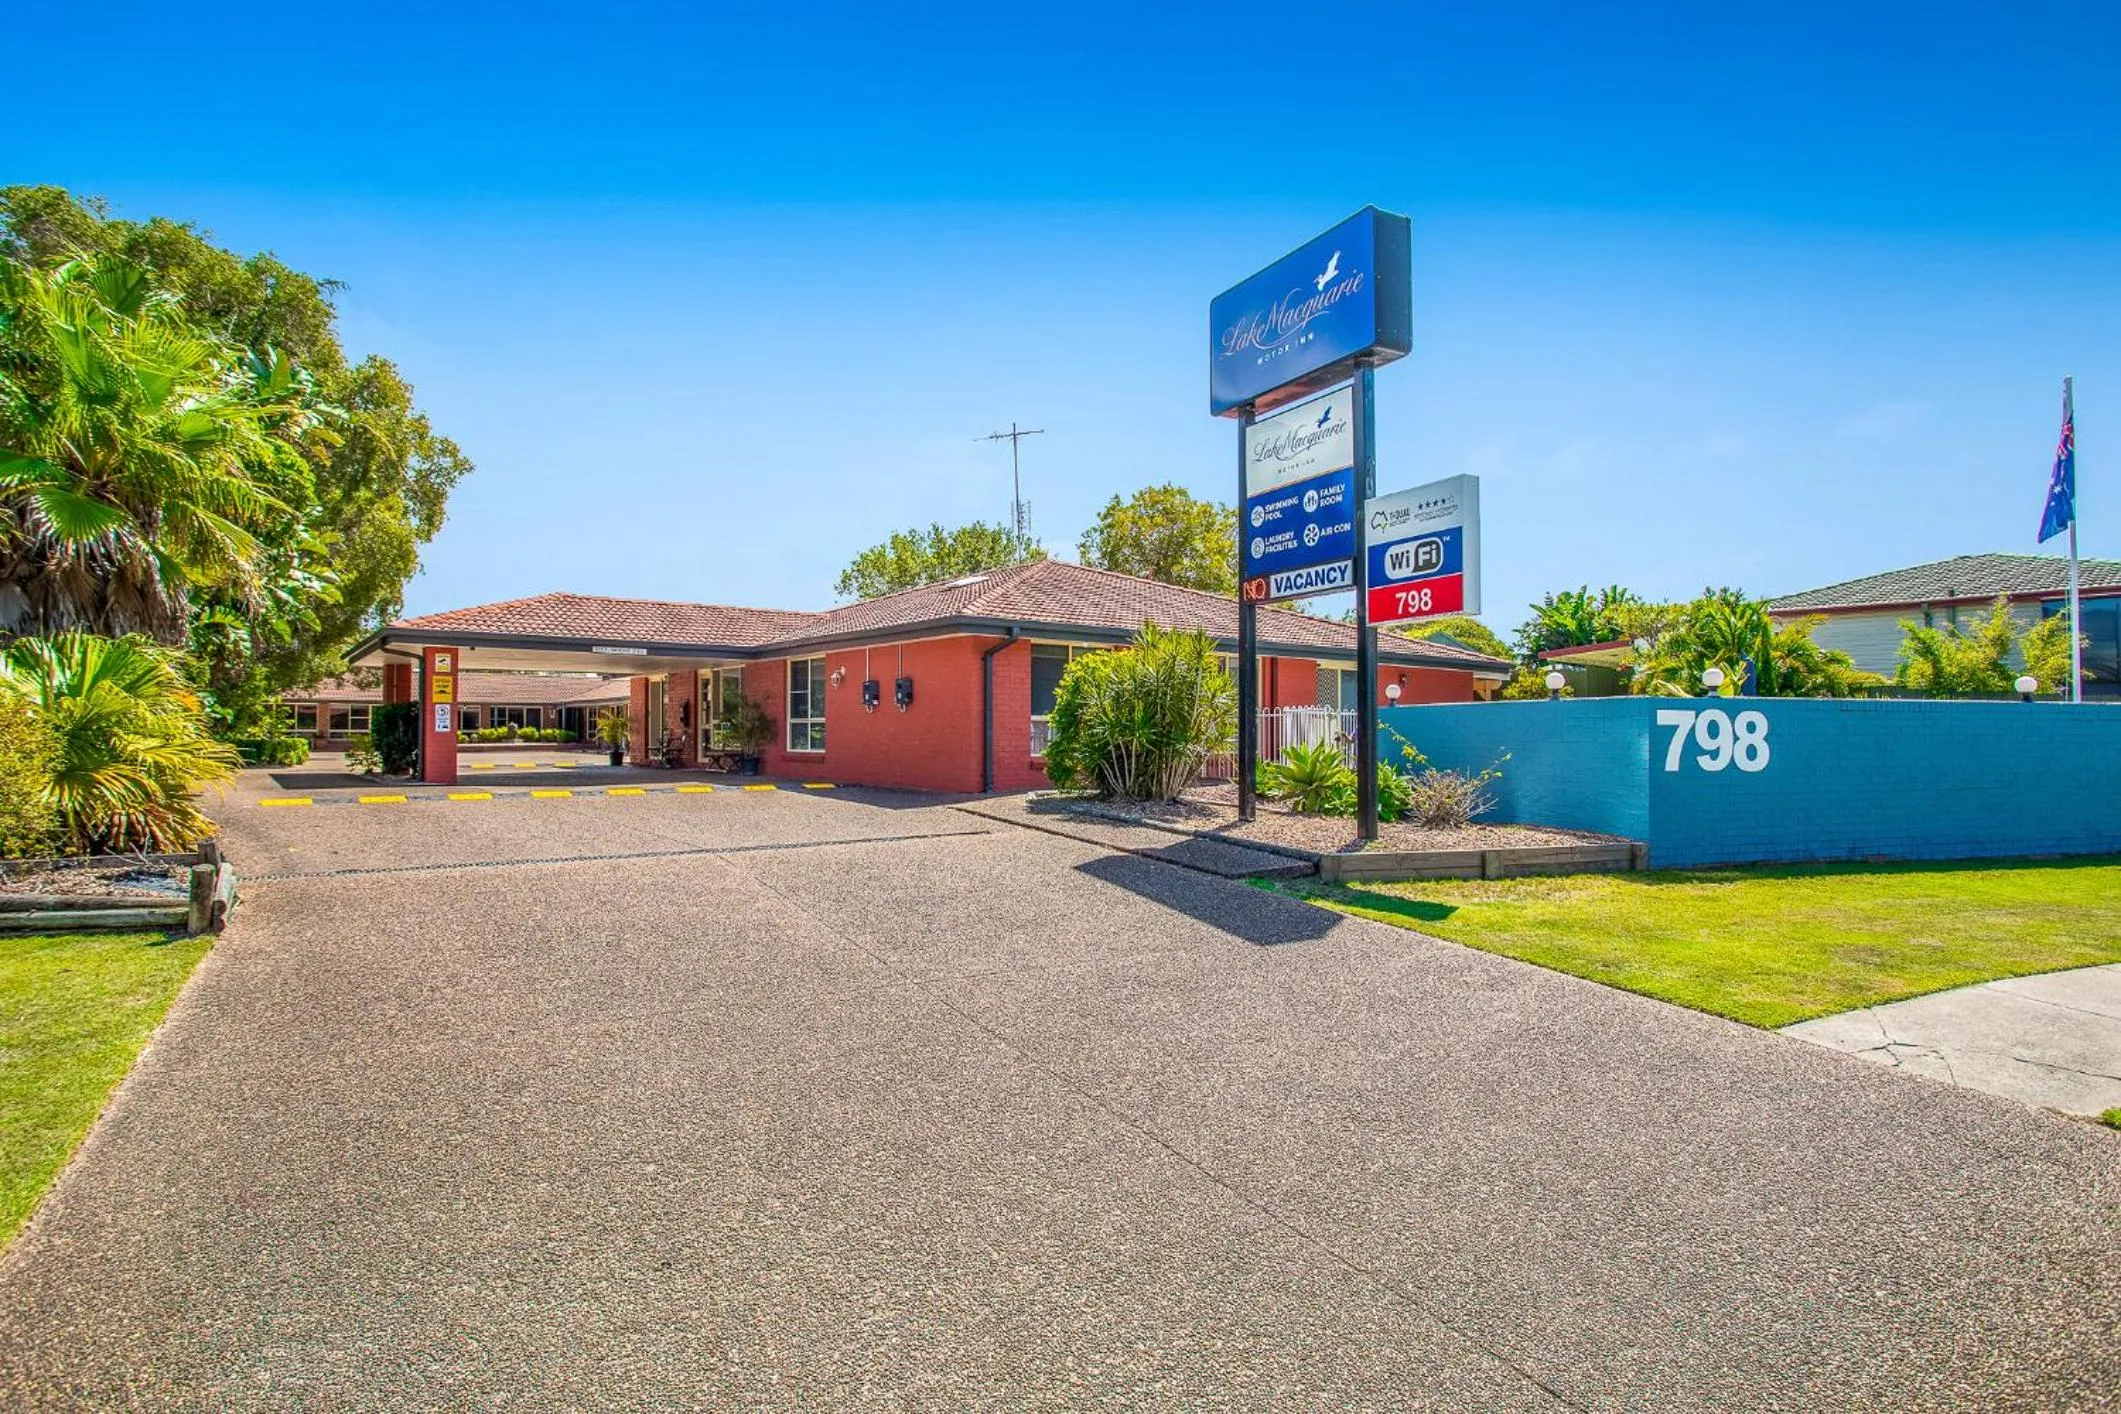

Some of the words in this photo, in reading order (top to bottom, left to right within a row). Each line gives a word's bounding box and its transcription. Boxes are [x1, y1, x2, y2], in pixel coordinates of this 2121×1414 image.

[1221, 312, 1266, 361] Lake
[1262, 269, 1364, 338] Macquarie
[1257, 345, 1289, 365] MOTOR
[1295, 332, 1314, 347] INN
[1252, 436, 1282, 464] Lake
[1281, 418, 1347, 451] Macquarie
[1320, 483, 1346, 498] FAMILY
[1265, 496, 1299, 512] SWIMMING
[1320, 494, 1343, 507] ROOM
[1265, 511, 1283, 521] POOL
[1320, 526, 1333, 537] AIR
[1334, 522, 1351, 533] CON
[1265, 531, 1295, 545] LAUNDRY
[1265, 540, 1298, 554] FACILITIES
[1243, 578, 1266, 602] NO
[1274, 564, 1349, 594] VACANCY
[1395, 588, 1432, 615] 798
[1656, 708, 1770, 772] 798
